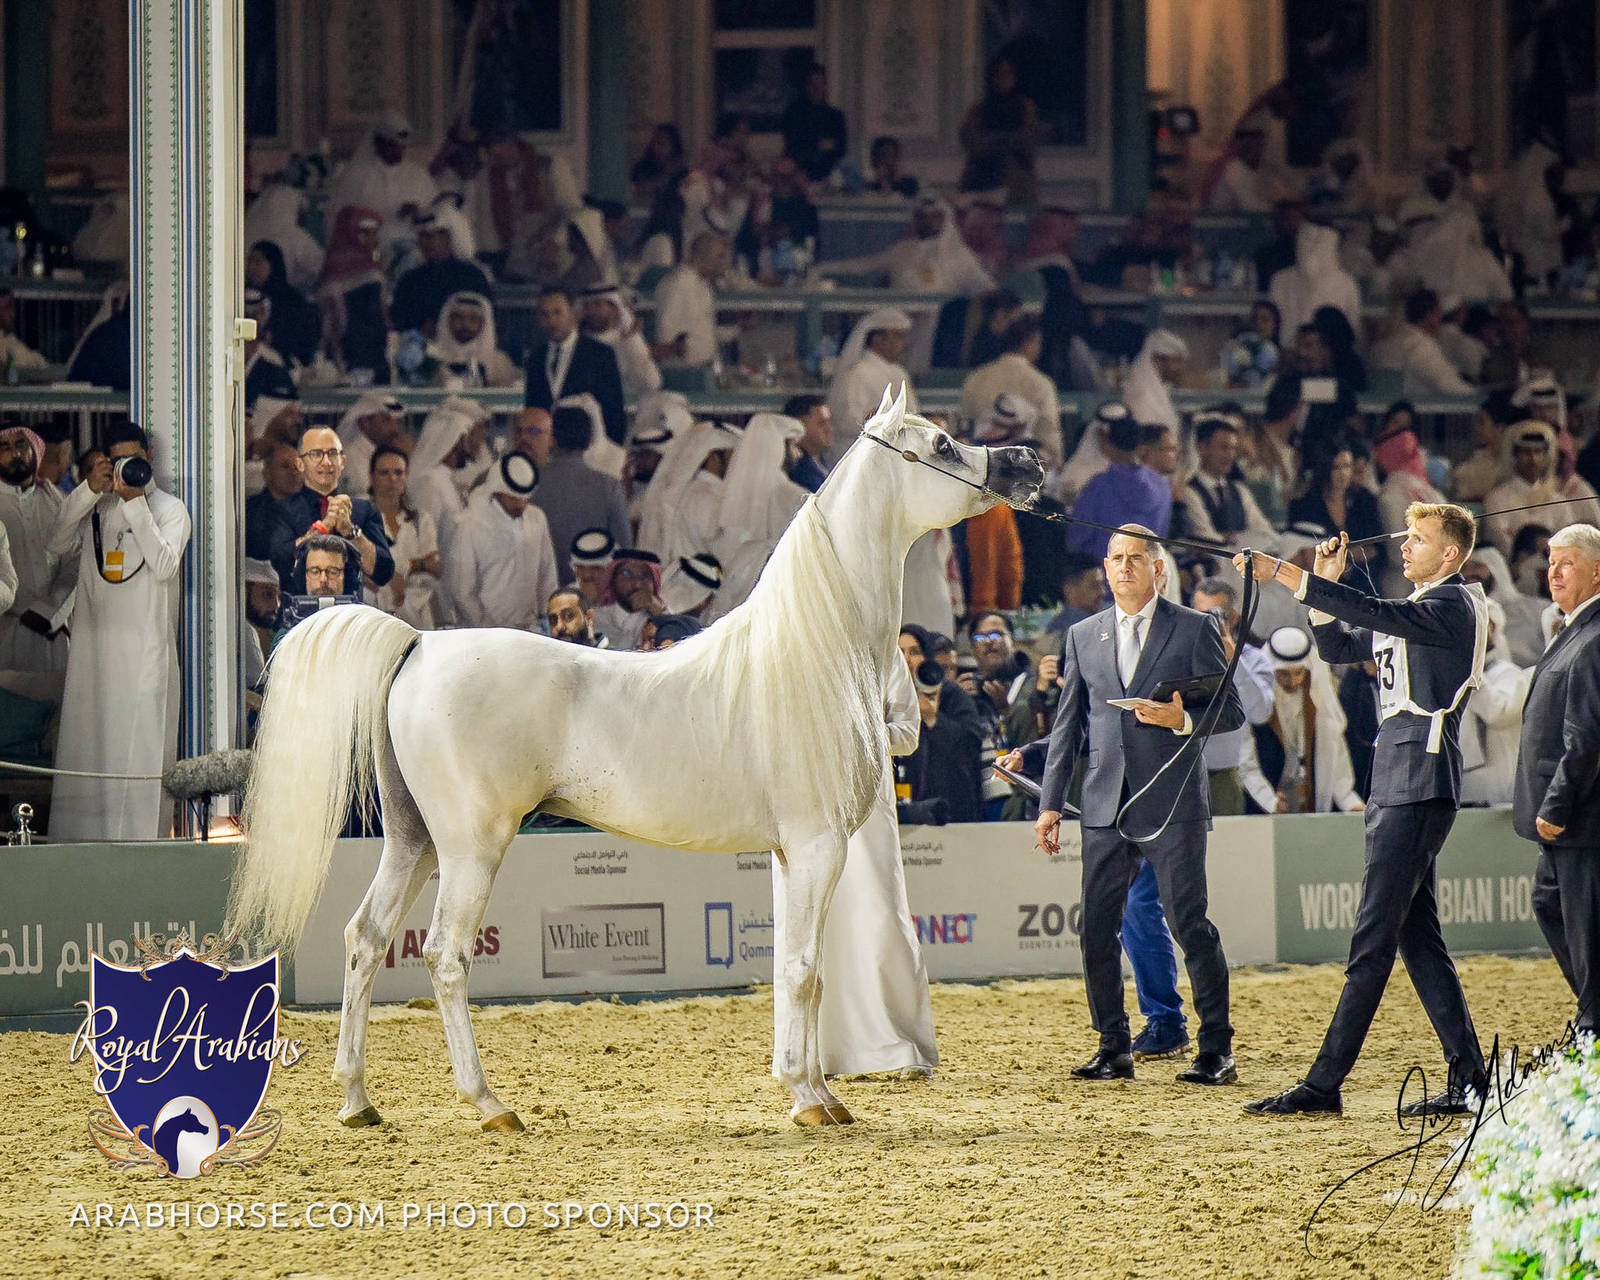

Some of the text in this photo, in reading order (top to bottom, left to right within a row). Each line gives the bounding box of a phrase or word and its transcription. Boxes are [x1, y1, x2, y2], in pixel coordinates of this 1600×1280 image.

[1437, 877, 1493, 925] BIAN
[548, 922, 649, 950] White Event
[911, 913, 977, 944] NNECT
